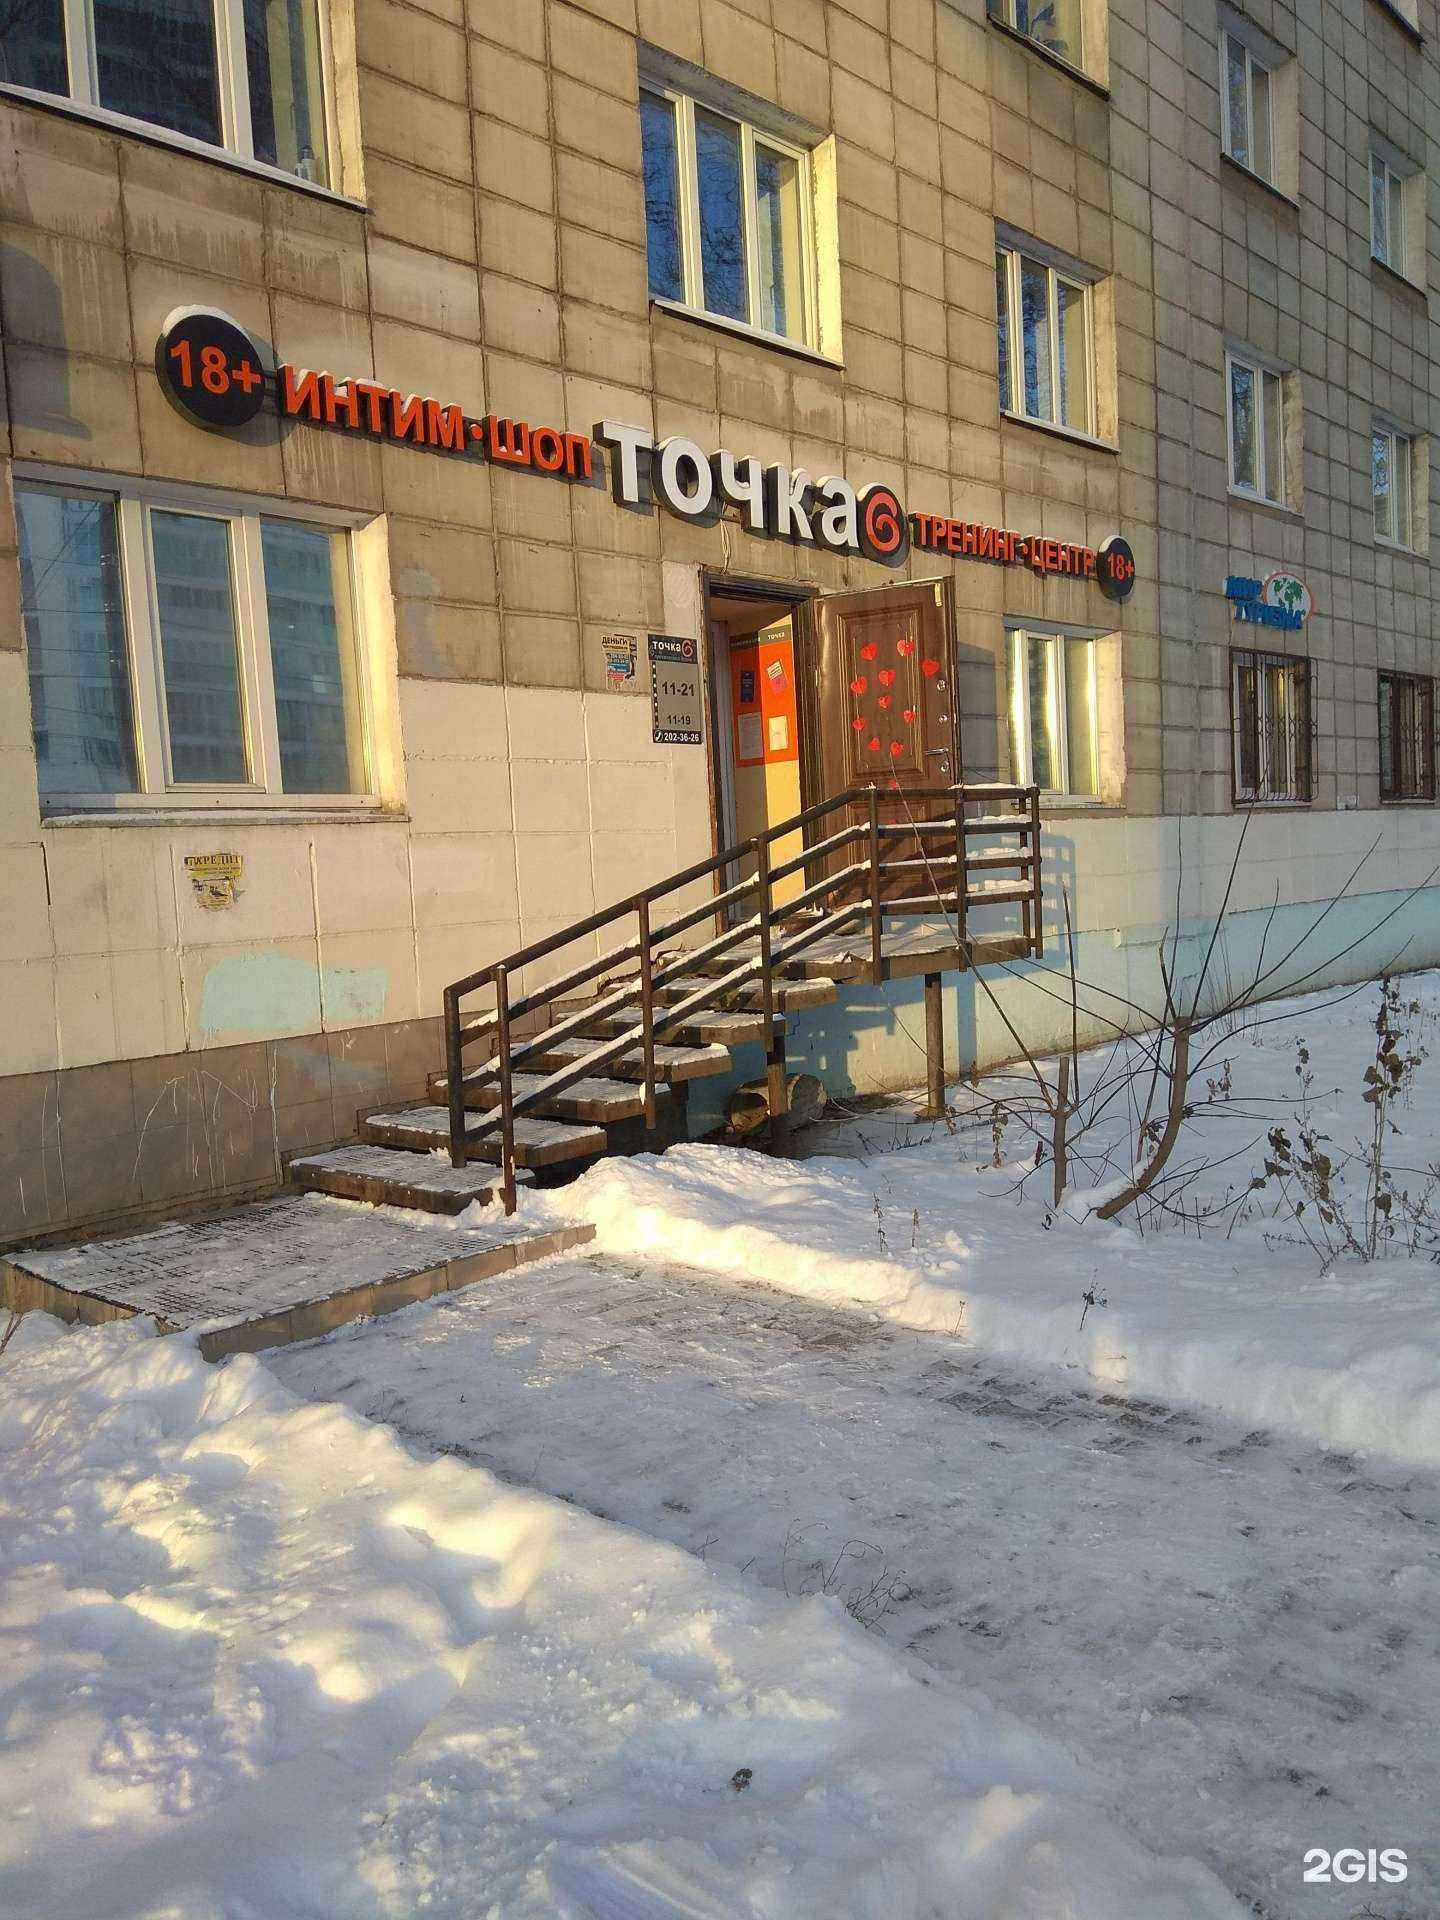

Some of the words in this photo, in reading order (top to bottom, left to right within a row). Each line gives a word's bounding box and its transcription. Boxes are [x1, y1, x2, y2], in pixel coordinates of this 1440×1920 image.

[170, 340, 262, 393] 18+
[1107, 552, 1134, 580] 18+
[662, 680, 695, 697] 11-21
[667, 714, 691, 726] 11-19
